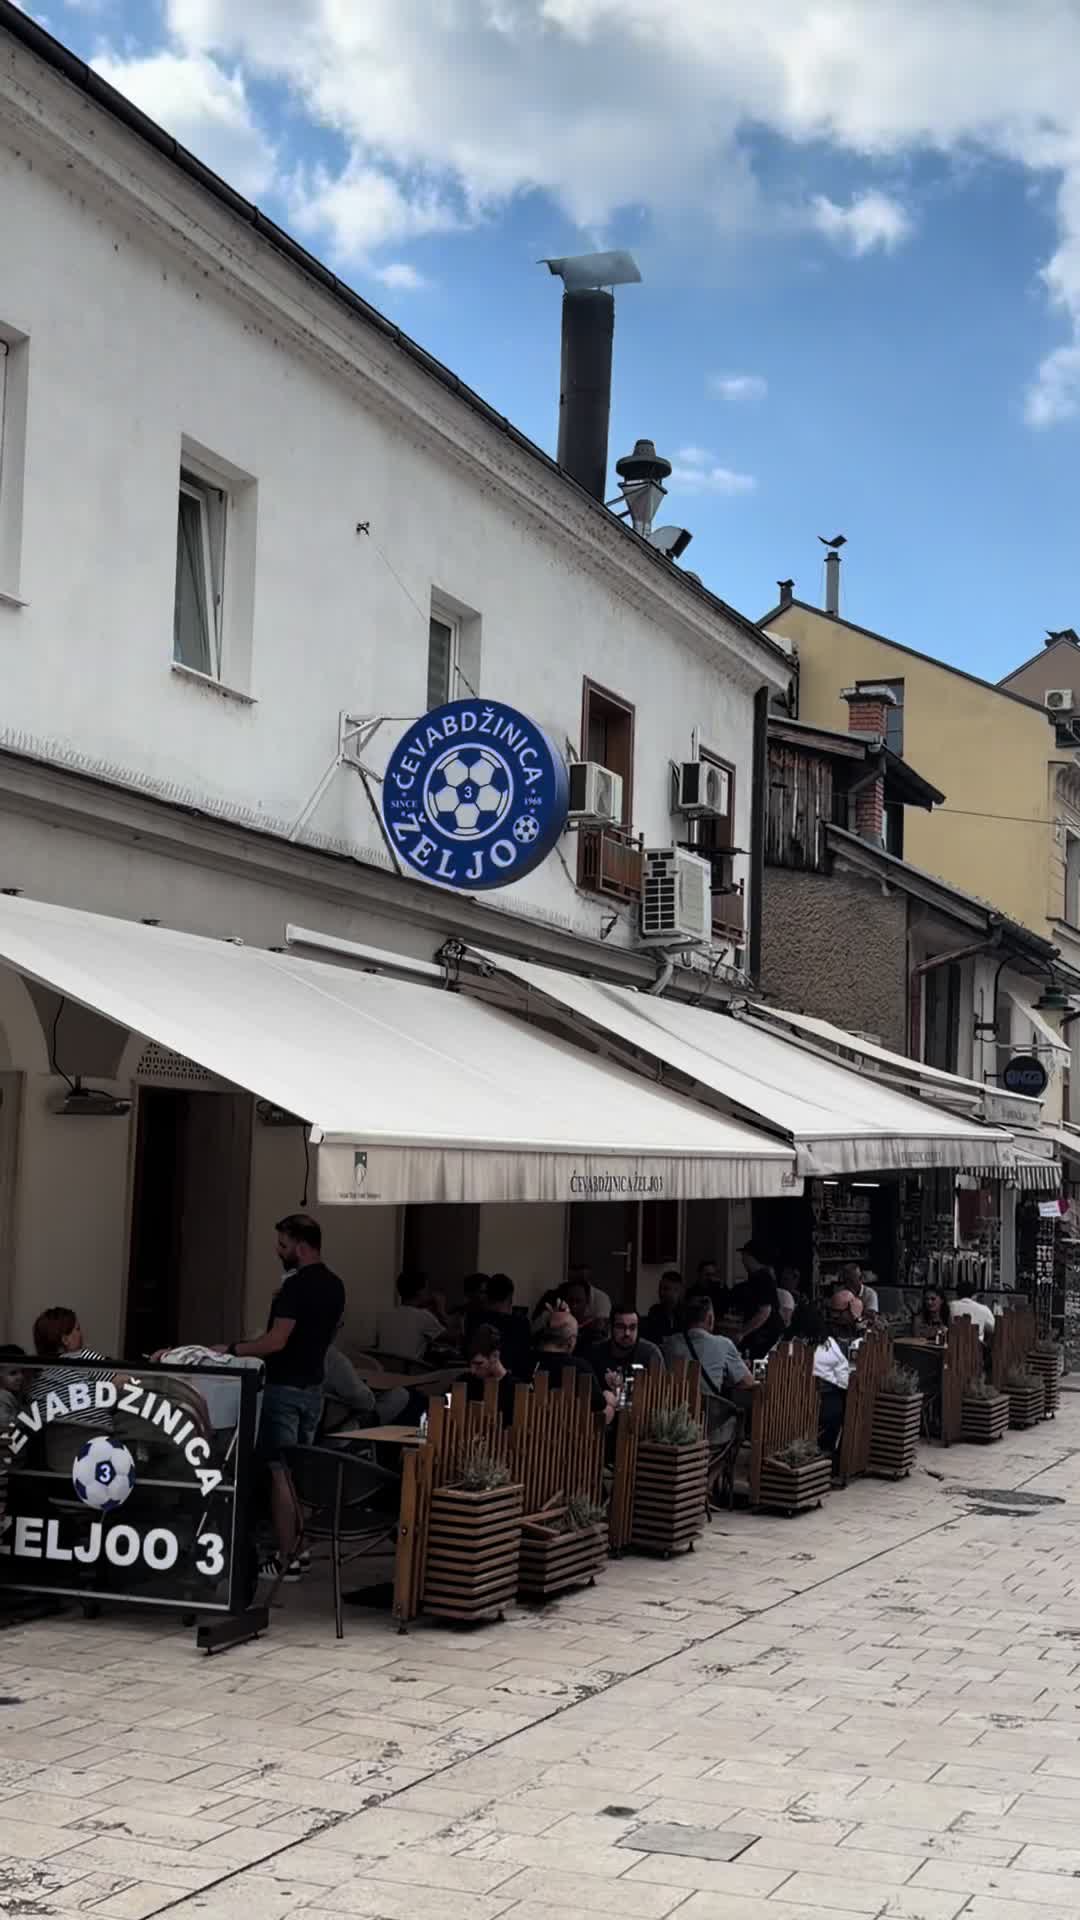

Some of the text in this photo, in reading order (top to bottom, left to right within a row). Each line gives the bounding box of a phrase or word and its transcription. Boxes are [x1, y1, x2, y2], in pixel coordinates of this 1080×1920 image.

[392, 706, 543, 790] ĆEVABDŽINICA
[391, 800, 418, 809] SINCE
[464, 786, 473, 799] 3
[392, 811, 517, 880] ŽELJO
[0, 1377, 223, 1497] EVABDŽINICA
[99, 1465, 110, 1483] 3
[196, 1532, 224, 1576] 3
